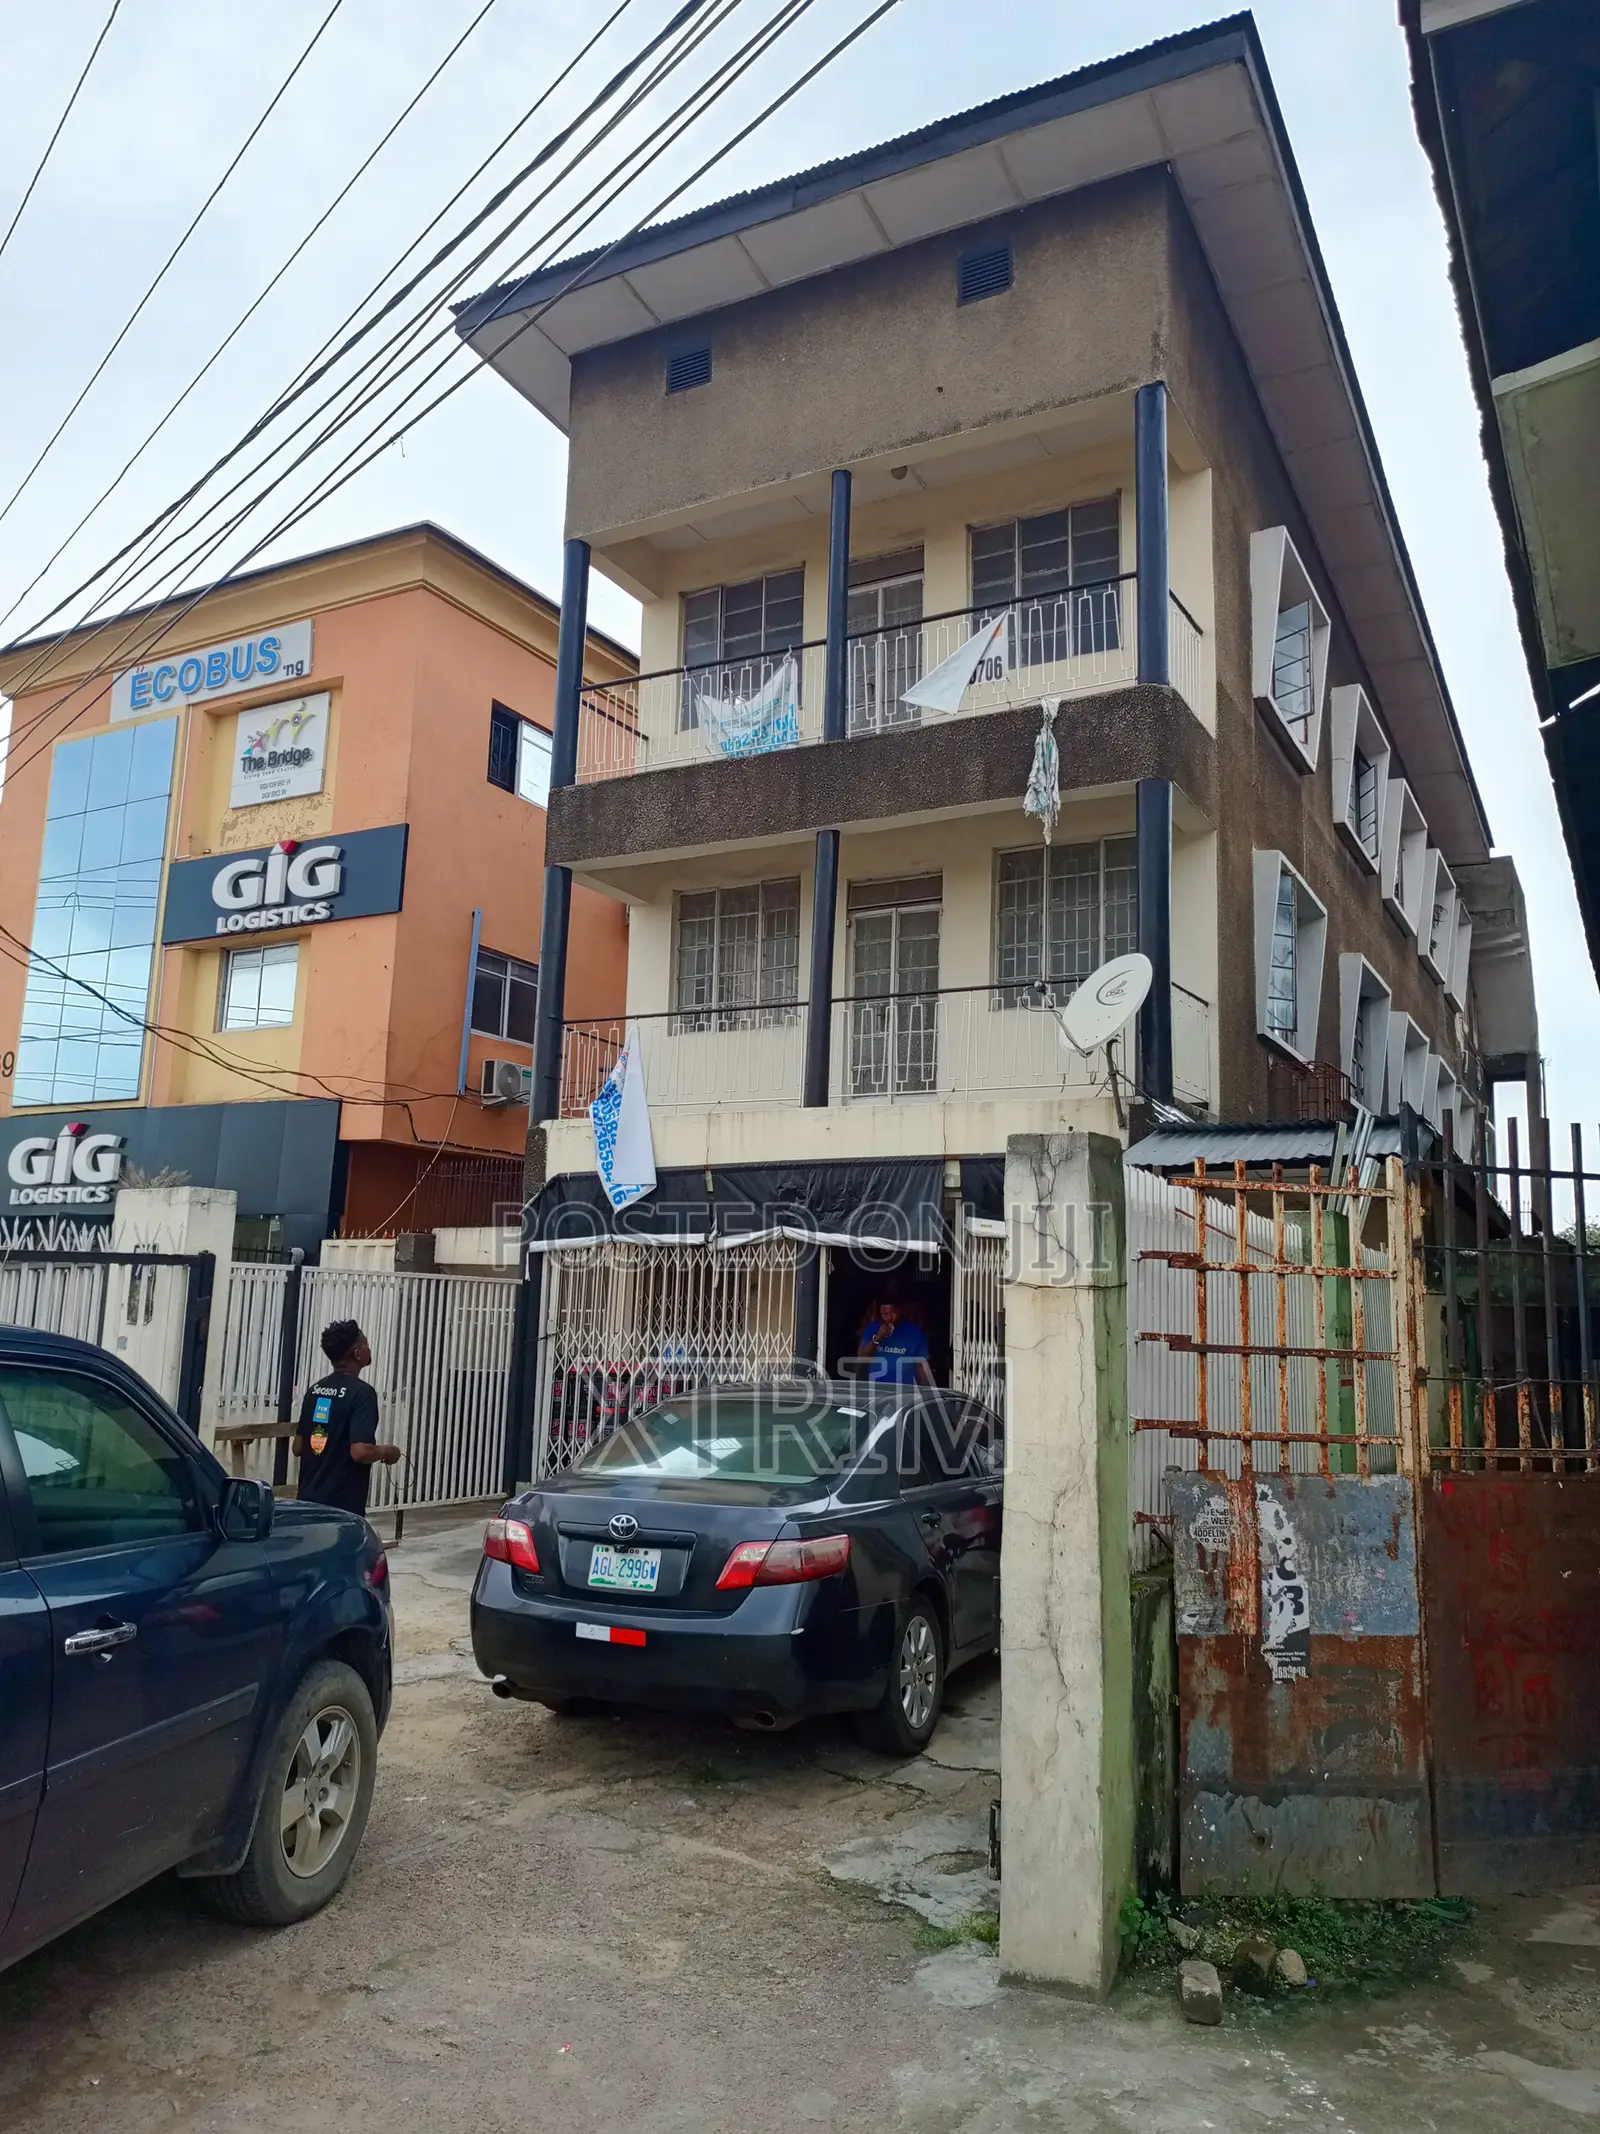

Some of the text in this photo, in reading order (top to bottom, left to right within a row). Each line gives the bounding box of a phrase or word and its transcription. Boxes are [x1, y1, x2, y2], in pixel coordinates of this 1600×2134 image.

[240, 747, 313, 773] The Bridge
[212, 840, 342, 910] GIG
[216, 901, 332, 934] LOGISTICS
[0, 1051, 15, 1078] 9
[8, 1121, 122, 1185] GIG
[9, 1186, 113, 1206] LOGISTICS
[312, 1384, 347, 1398] Season 5
